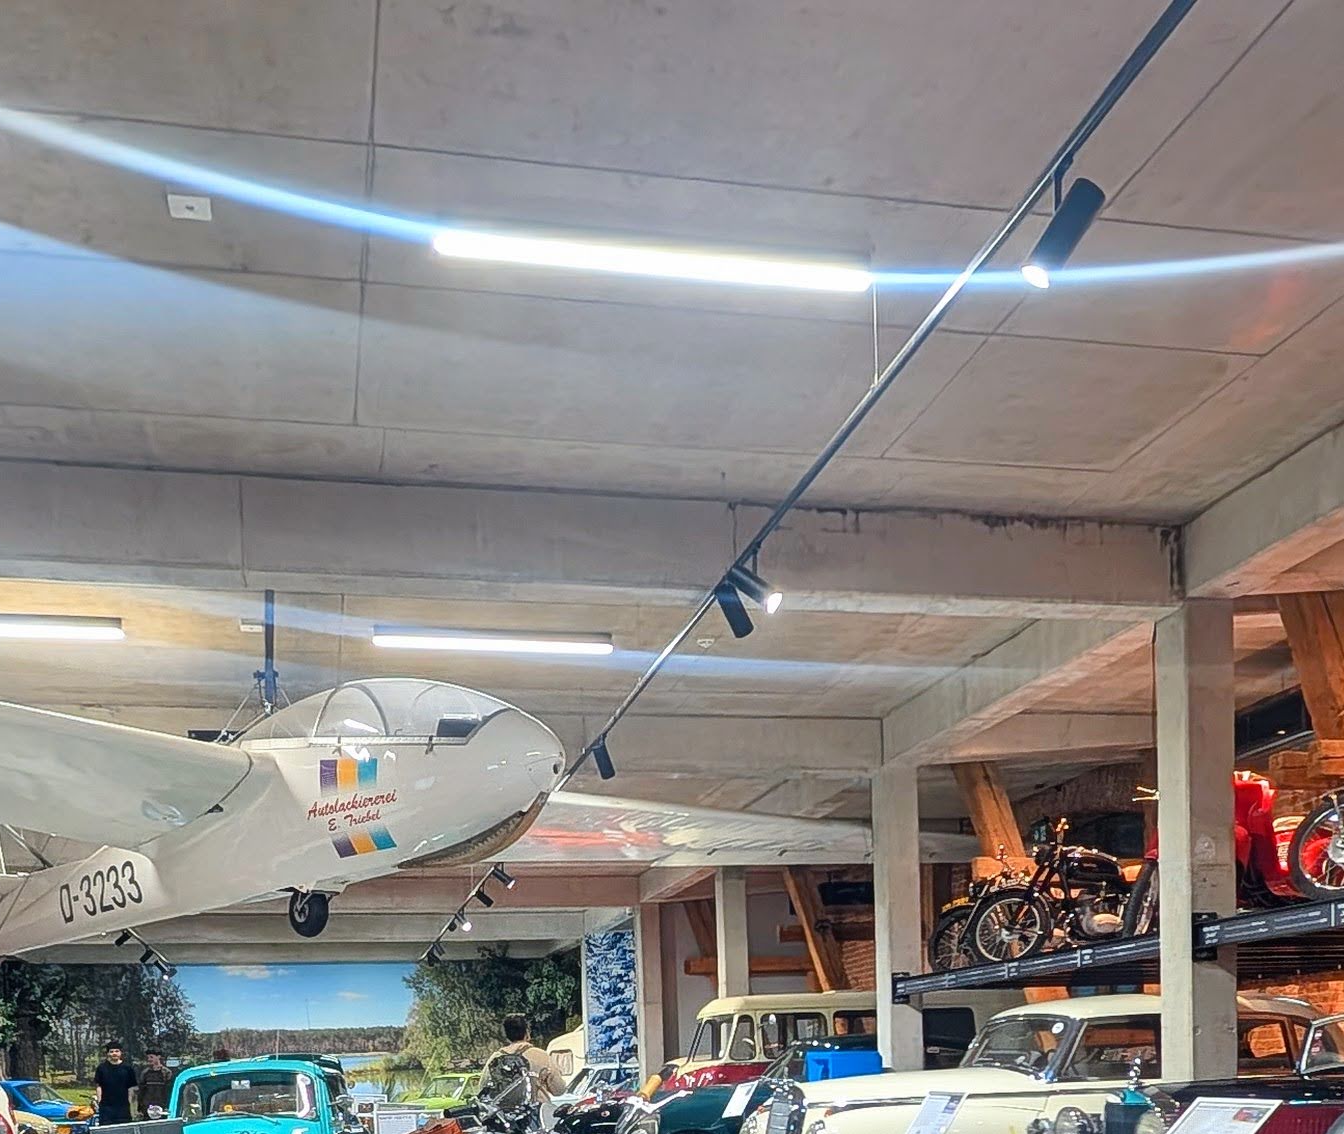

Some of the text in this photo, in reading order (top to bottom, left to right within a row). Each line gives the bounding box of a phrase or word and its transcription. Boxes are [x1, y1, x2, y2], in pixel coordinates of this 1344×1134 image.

[307, 789, 398, 820] Autolackiererei
[328, 810, 381, 831] E. Triebel
[60, 861, 142, 923] D-3233
